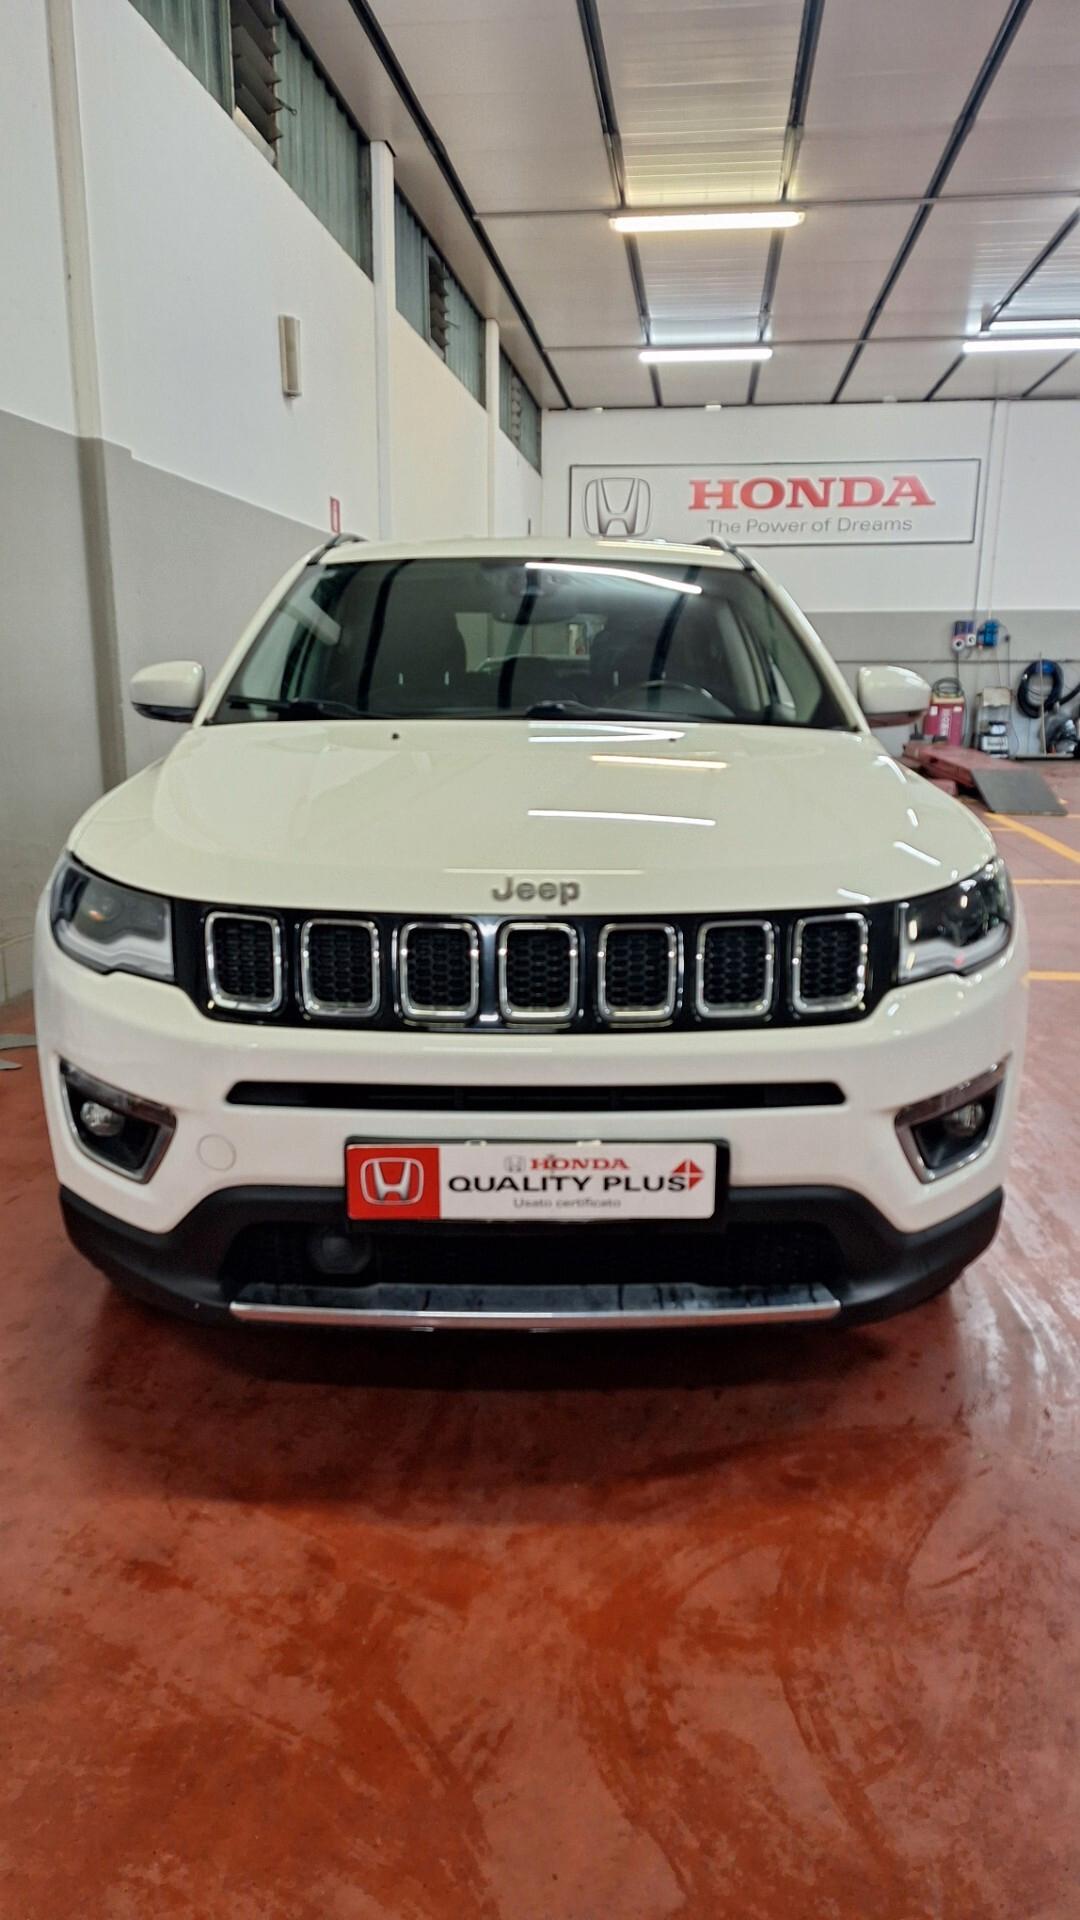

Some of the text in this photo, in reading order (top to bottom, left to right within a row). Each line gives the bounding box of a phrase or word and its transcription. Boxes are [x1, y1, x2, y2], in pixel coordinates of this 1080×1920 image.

[688, 475, 936, 510] HONDA
[707, 517, 913, 534] The Power of Dreams
[492, 877, 580, 906] Jeep
[530, 1158, 630, 1171] HONDA
[448, 1176, 686, 1193] QUALITY PLUS
[513, 1198, 621, 1209] Usato certificato
